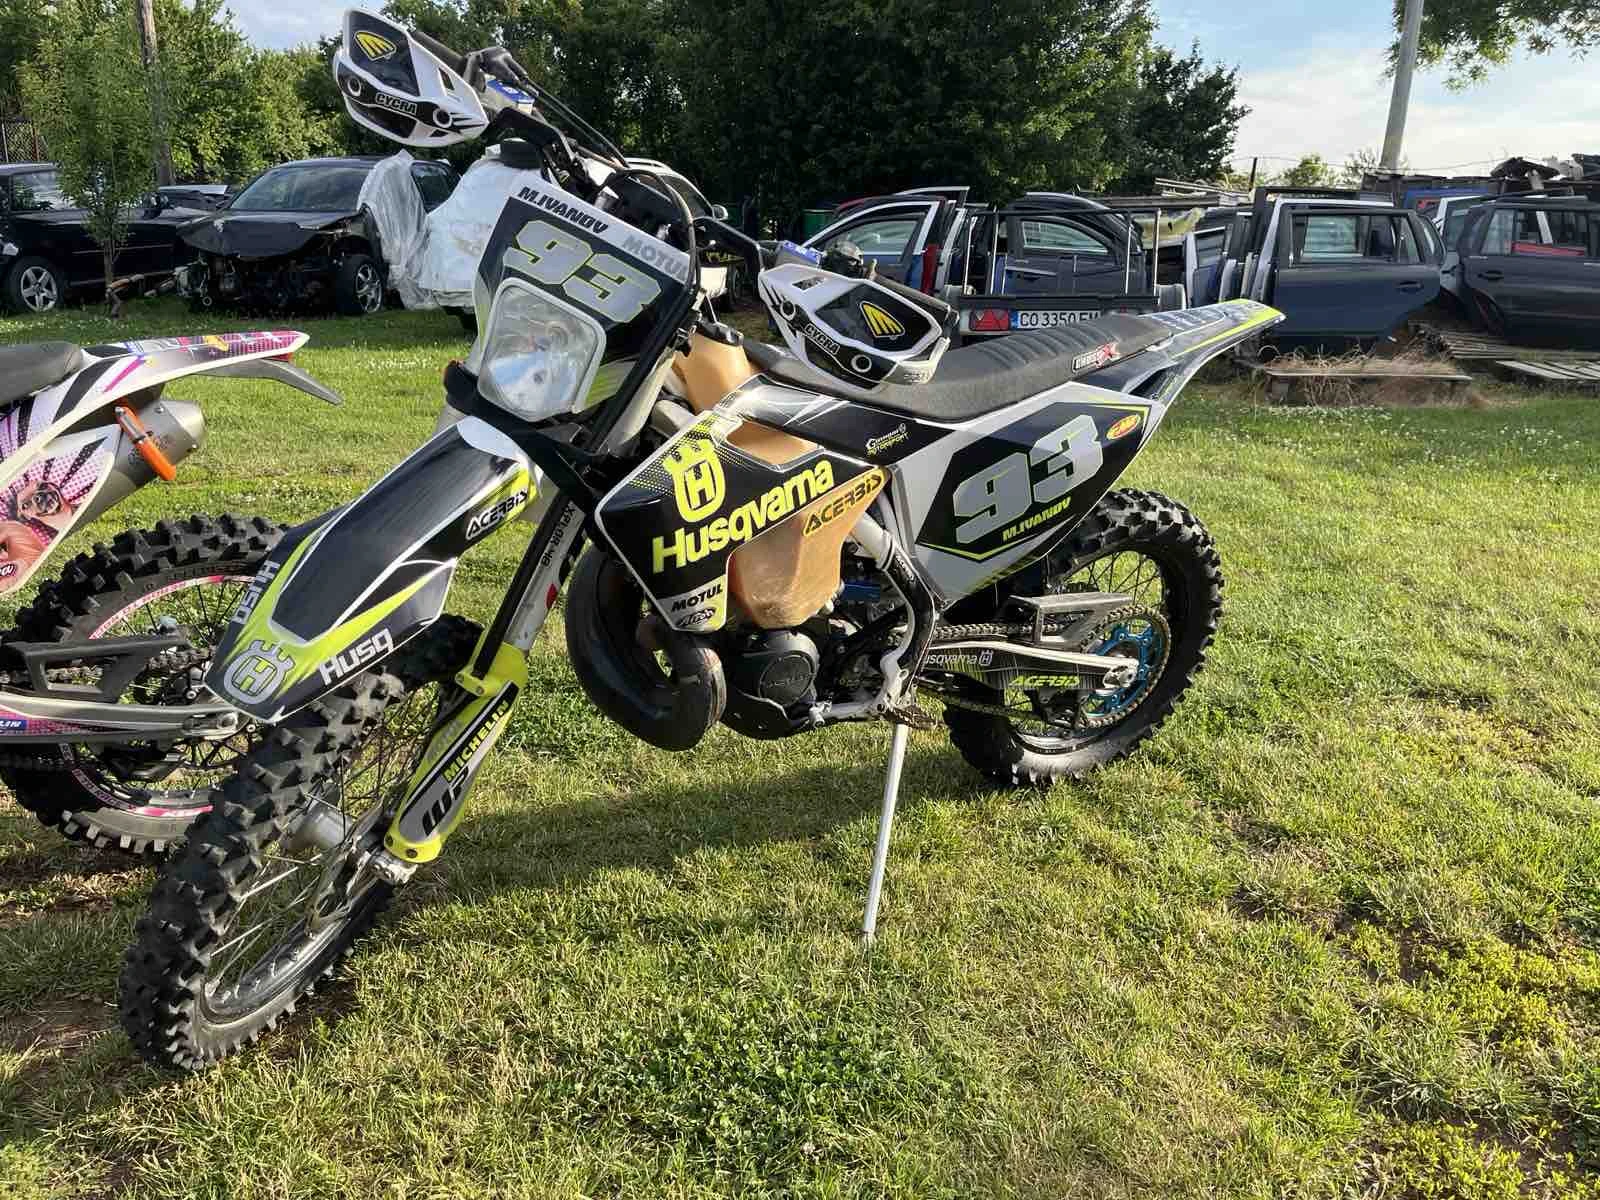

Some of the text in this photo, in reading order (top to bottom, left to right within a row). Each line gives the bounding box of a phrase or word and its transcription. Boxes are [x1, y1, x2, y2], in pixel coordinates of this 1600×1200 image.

[376, 93, 417, 115] CYCRA
[517, 186, 608, 234] M.IVANOV
[503, 220, 662, 323] 93
[805, 323, 840, 356] CYCRA
[804, 474, 883, 534] ACERBIS
[953, 414, 1103, 544] 93
[467, 490, 528, 538] ACERBIS
[652, 460, 835, 574] Husqvarna
[1002, 496, 1071, 542] M.IVANOV
[671, 583, 724, 612] MOTUL
[319, 627, 394, 686] Husq
[444, 700, 510, 782] MICHELIN
